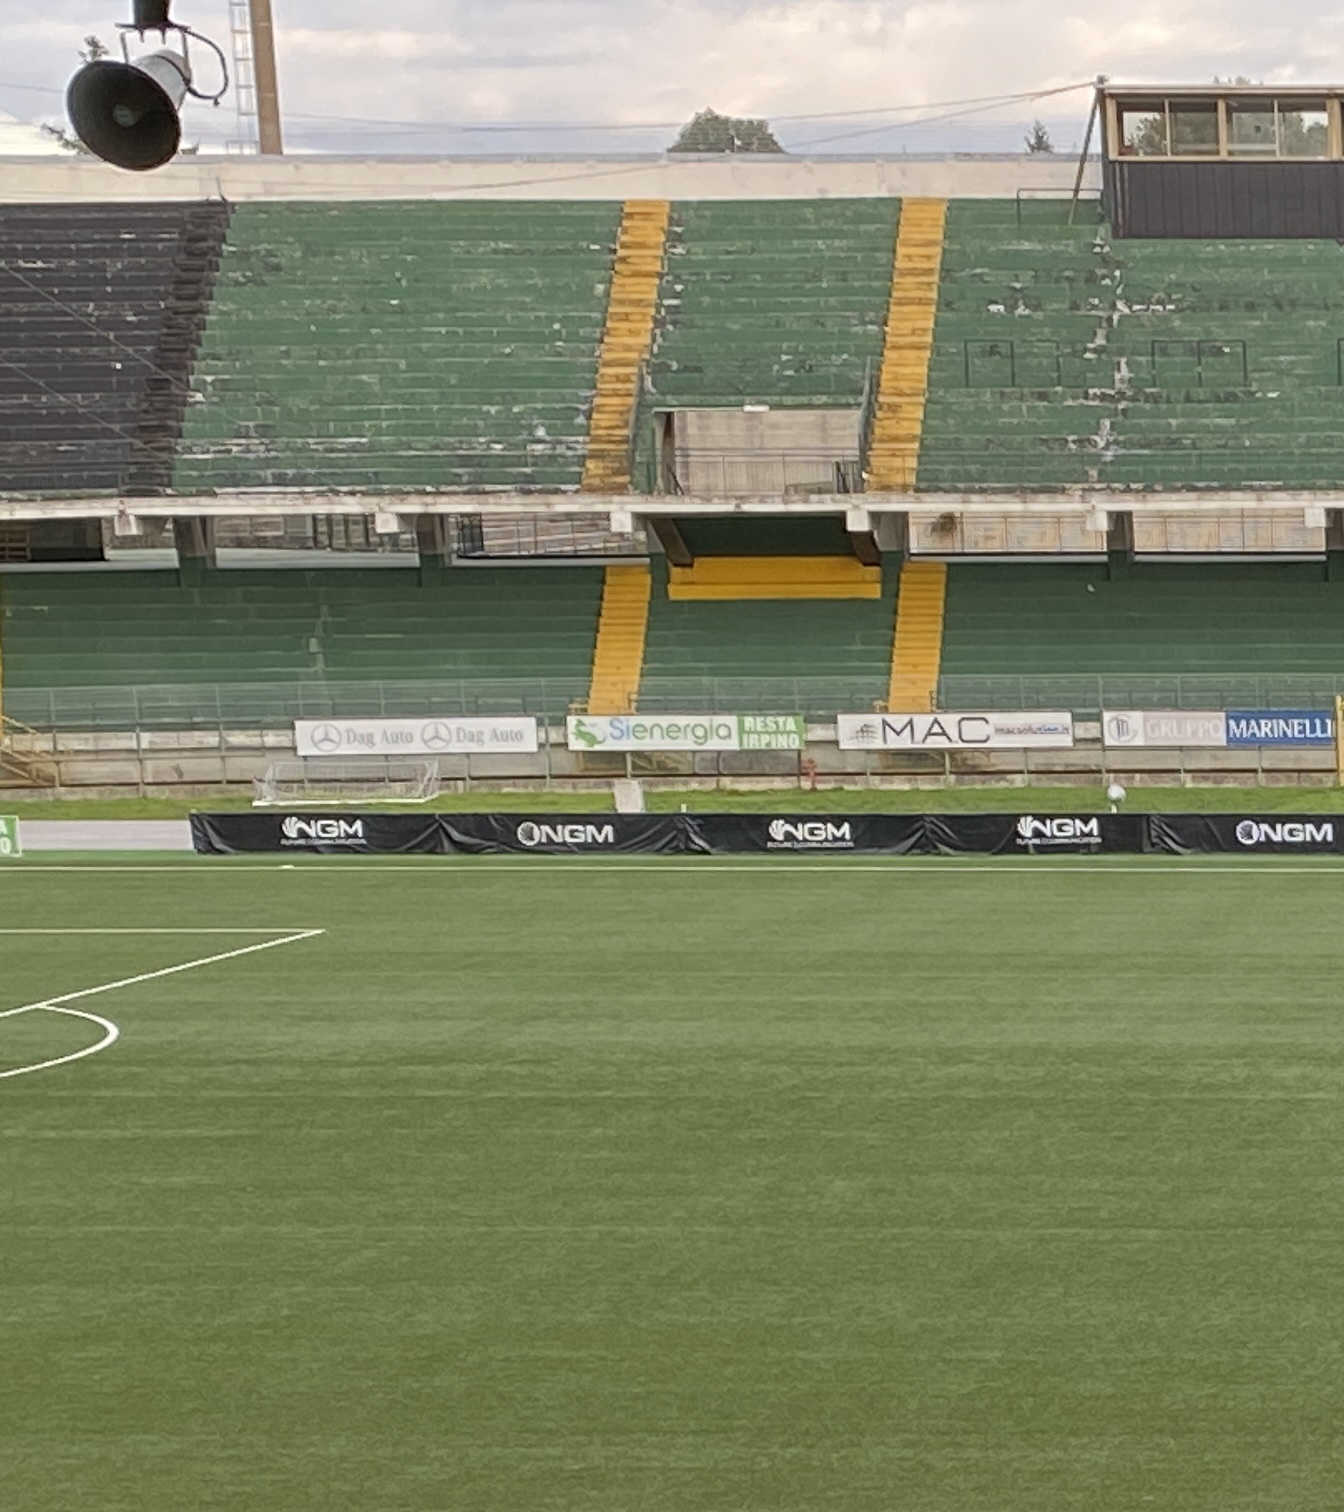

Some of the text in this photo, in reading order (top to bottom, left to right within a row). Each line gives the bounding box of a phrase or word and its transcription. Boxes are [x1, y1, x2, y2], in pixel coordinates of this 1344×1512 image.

[609, 717, 732, 746] Sienergia
[744, 716, 798, 731] RESTA
[1146, 719, 1222, 738] GRUPPO
[1228, 718, 1332, 739] MARINELLI
[346, 728, 414, 747] Dag Auto
[455, 726, 524, 745] Dag Auto
[296, 819, 363, 837] NGM
[540, 824, 614, 843] NGM
[784, 822, 851, 840] NGM
[1031, 817, 1098, 837] NGM
[1259, 823, 1333, 842] NGM
